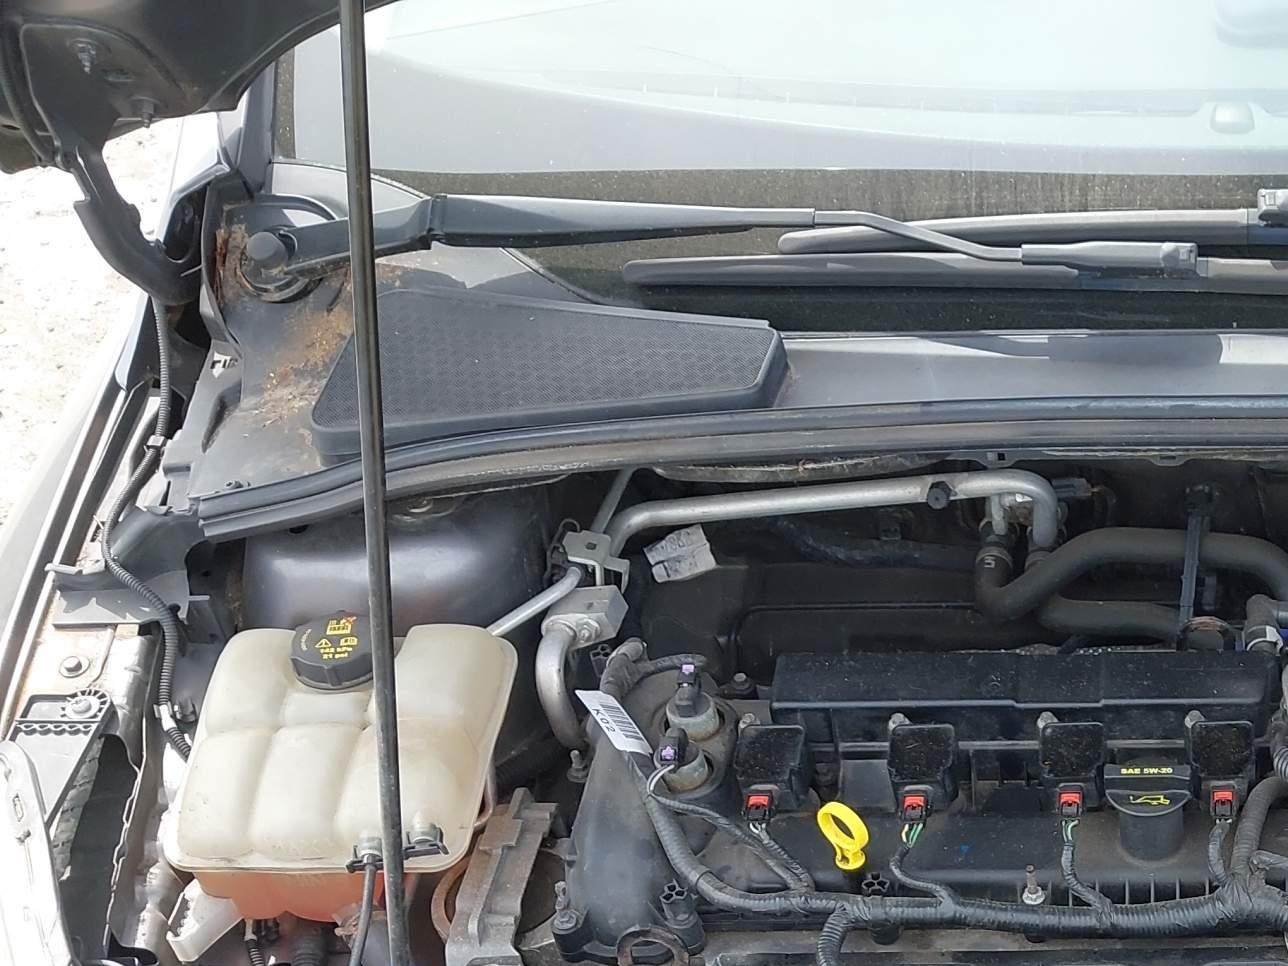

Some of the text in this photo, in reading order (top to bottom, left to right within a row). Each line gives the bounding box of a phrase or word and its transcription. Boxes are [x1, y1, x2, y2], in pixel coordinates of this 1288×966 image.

[591, 708, 616, 733] K02
[1120, 767, 1174, 775] SAE 5W-20
